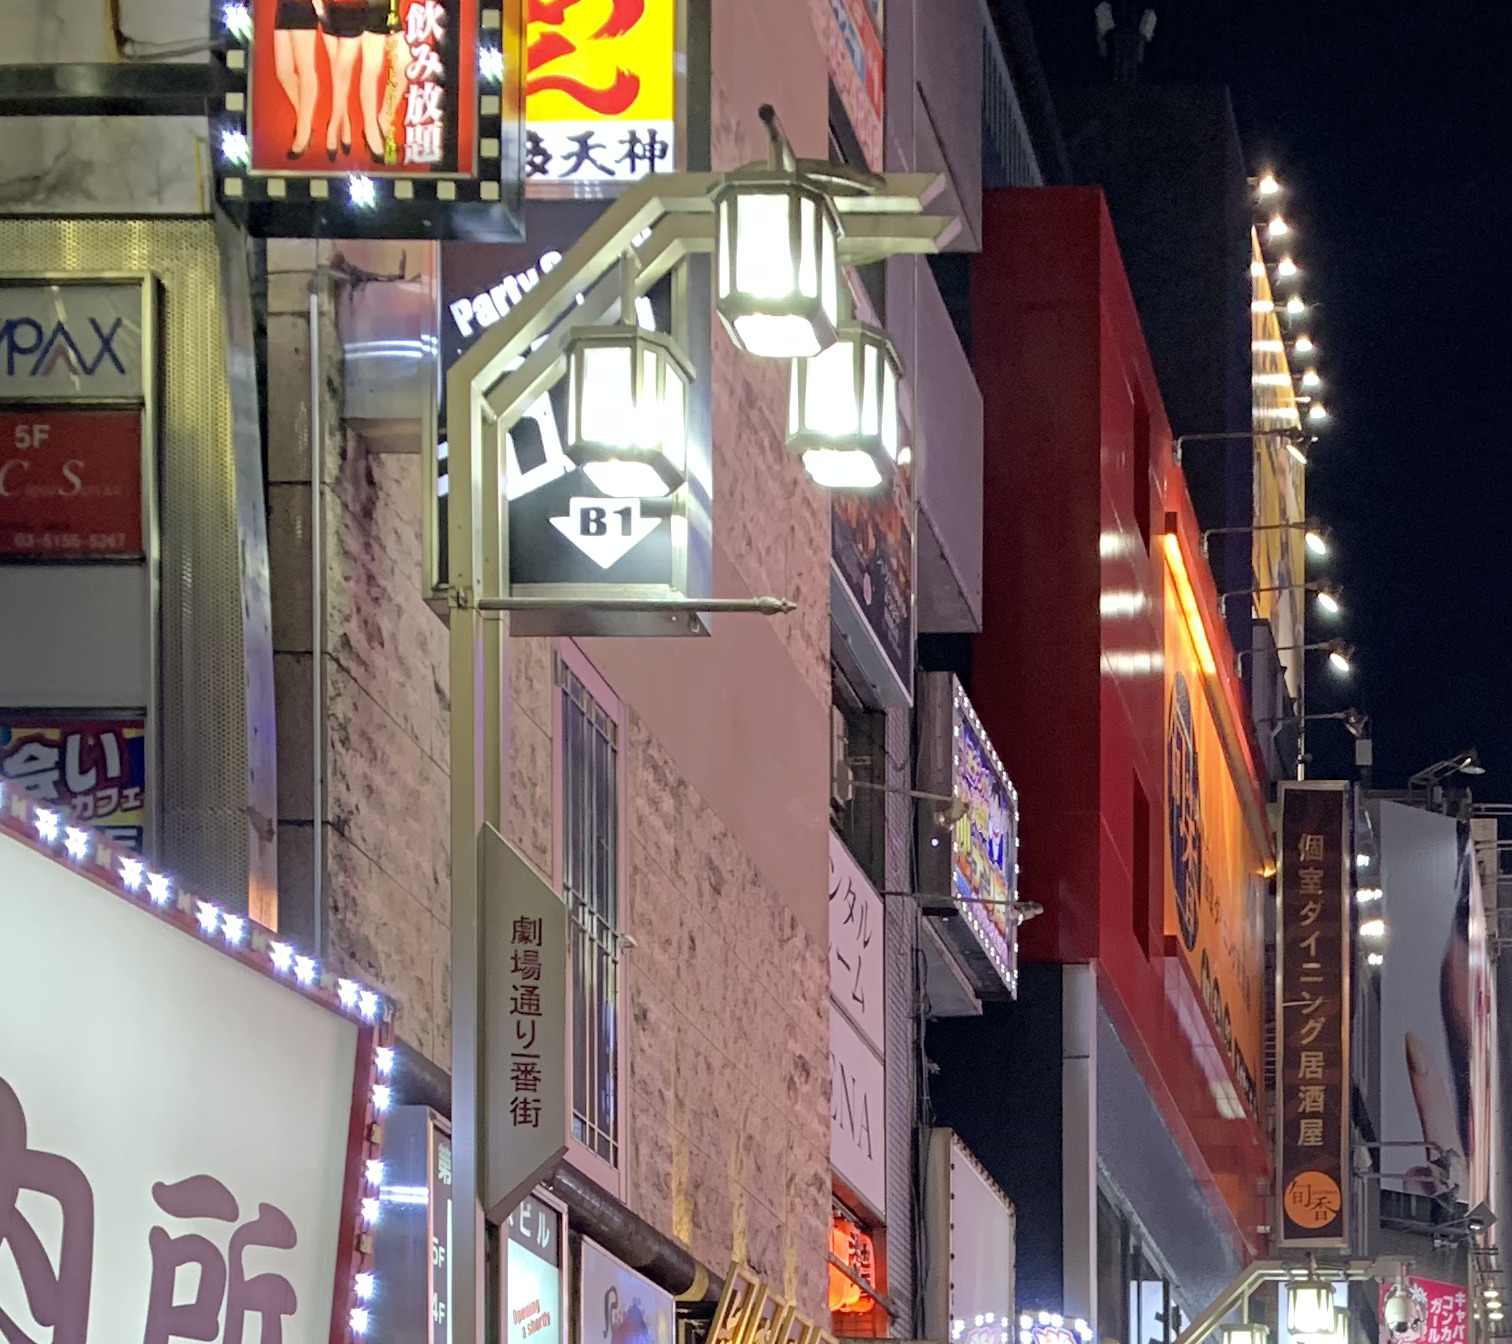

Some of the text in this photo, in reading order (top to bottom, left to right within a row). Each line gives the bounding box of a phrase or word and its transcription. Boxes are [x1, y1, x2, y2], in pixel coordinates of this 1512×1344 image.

[404, 0, 446, 165] 飲み放題
[15, 424, 49, 448] 5F
[579, 506, 634, 537] B1
[70, 785, 142, 822] カフェ
[1297, 833, 1324, 1148] 個室ダイニング居酒屋
[510, 914, 543, 1129] 劇場通り一番街
[432, 1292, 446, 1325] 4F
[512, 1298, 542, 1326] Opening
